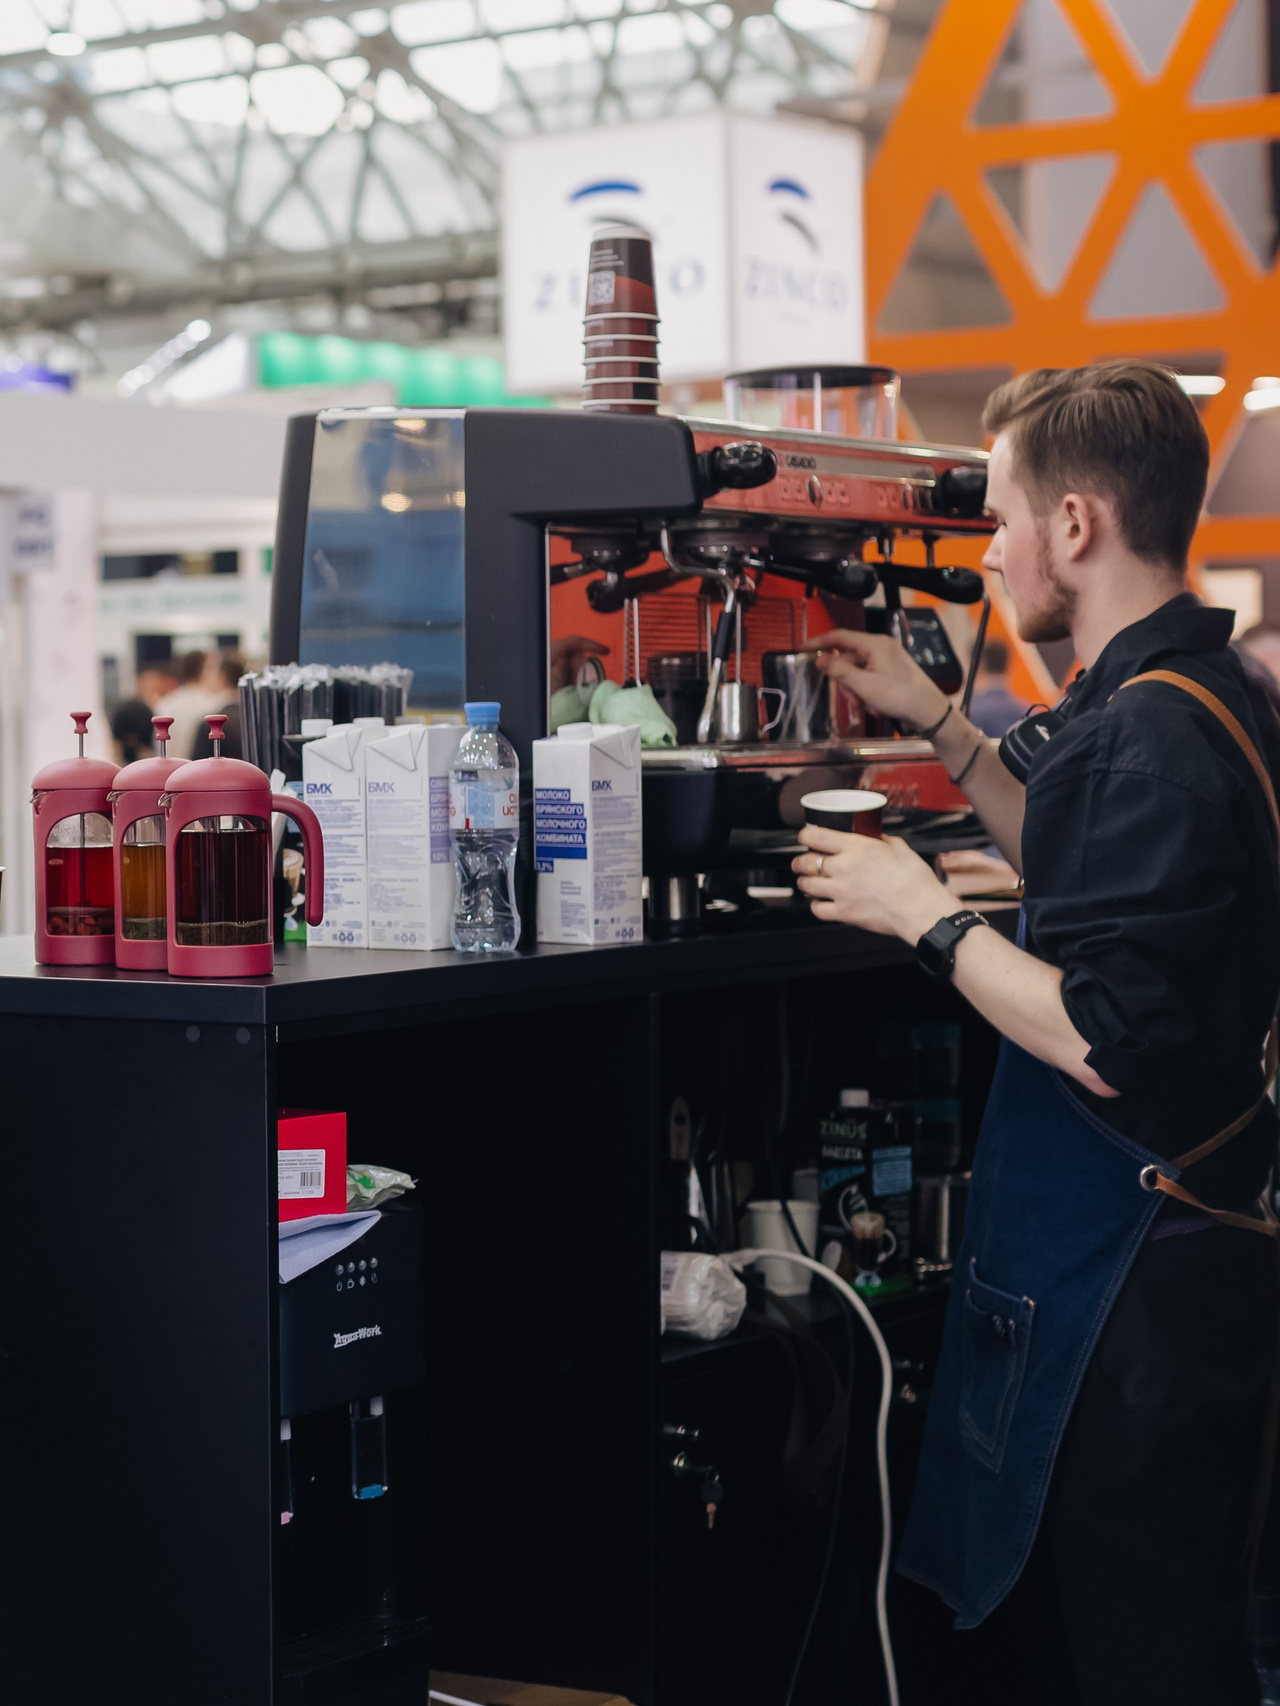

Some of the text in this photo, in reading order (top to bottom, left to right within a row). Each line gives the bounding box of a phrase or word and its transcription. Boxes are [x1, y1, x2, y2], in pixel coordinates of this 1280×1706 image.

[306, 783, 332, 794] БМК
[535, 789, 570, 801] МОЛОКО
[535, 804, 583, 815] БРЯНСКОГО
[536, 818, 586, 830] МОЛОЧНОГО
[536, 833, 584, 844] КОМБИНАТА
